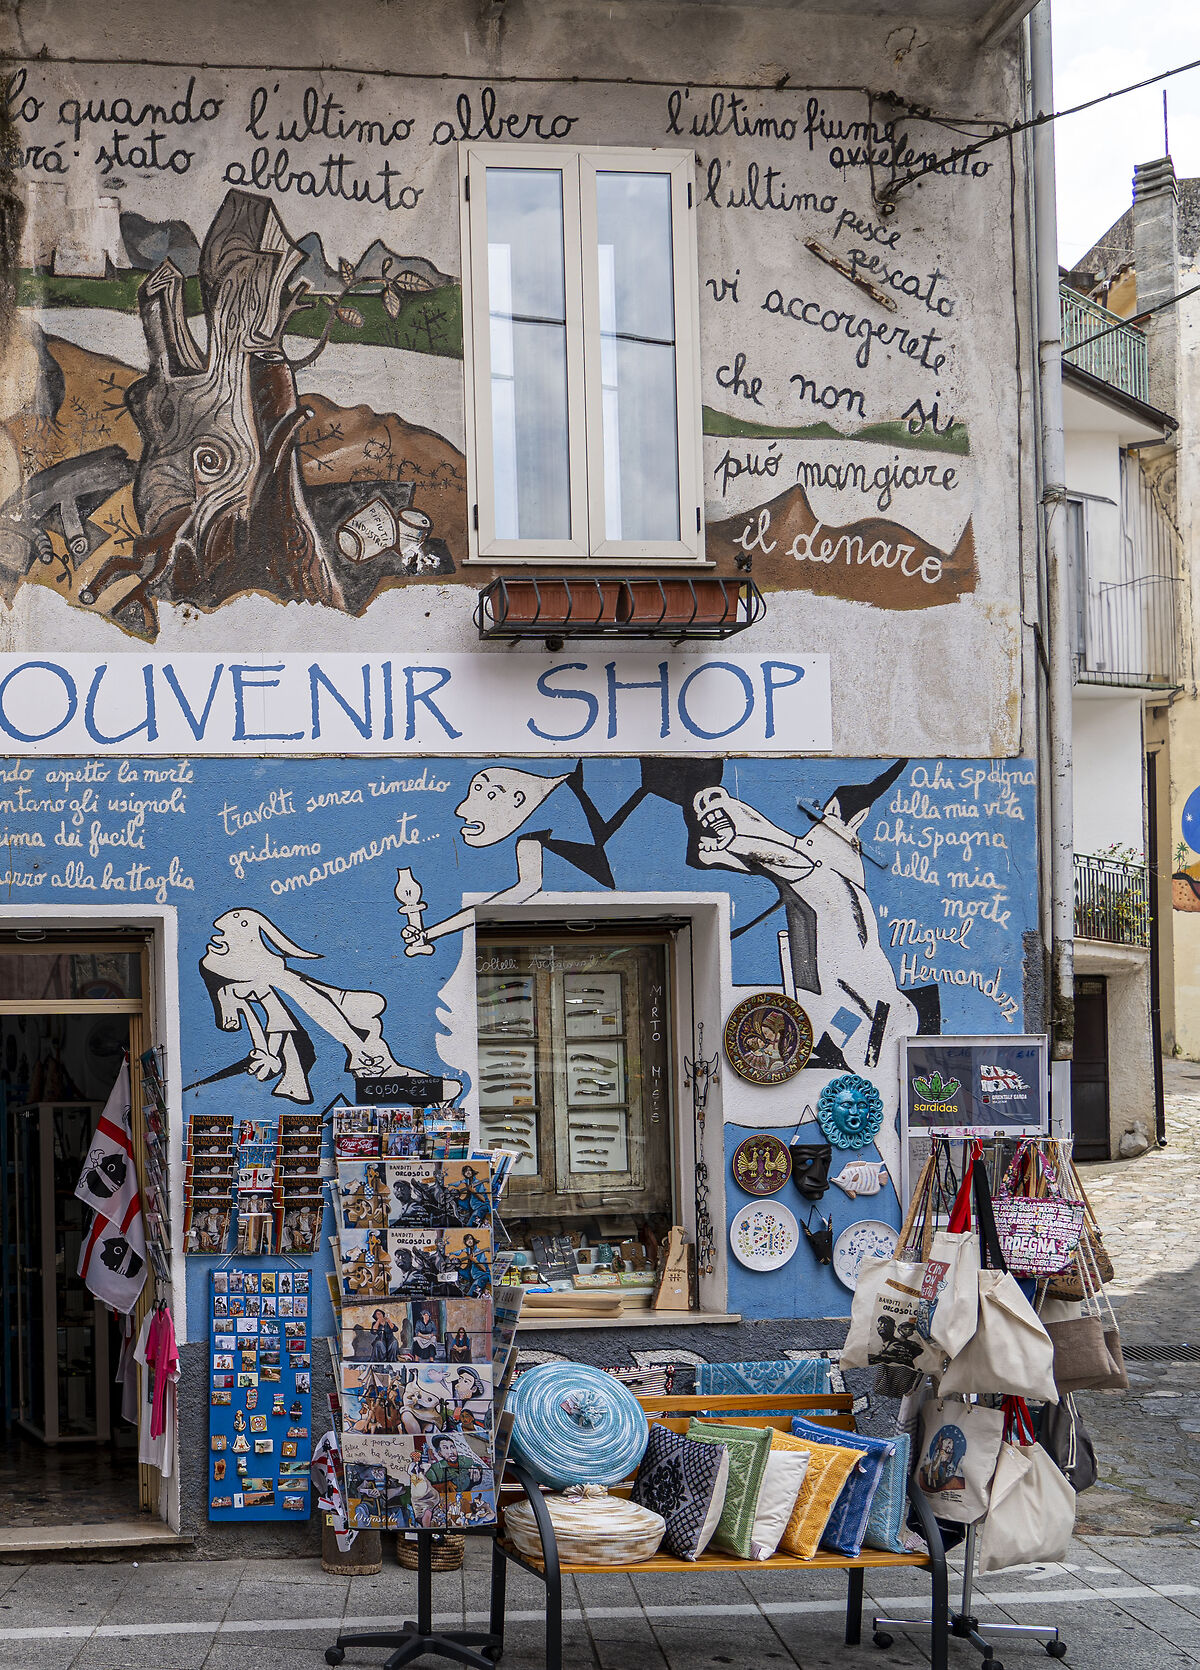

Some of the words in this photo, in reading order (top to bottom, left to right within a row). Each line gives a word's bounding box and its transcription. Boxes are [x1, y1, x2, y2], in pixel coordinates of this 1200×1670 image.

[57, 77, 224, 141] quando
[245, 84, 416, 143] l'ultimo
[430, 87, 579, 146] albero
[665, 88, 797, 139] l'ultimo
[804, 98, 897, 151] fiume
[96, 129, 196, 176] stato
[222, 147, 424, 211] abbattuto
[704, 157, 838, 213] l'ultimo
[832, 207, 901, 250] pesce
[848, 247, 954, 318] pescato
[706, 269, 741, 304] vi
[761, 289, 946, 375] accorgerete
[716, 352, 765, 406] che
[790, 373, 866, 418] non
[902, 391, 954, 434] si
[796, 455, 959, 512] mangiare
[369, 508, 392, 541] RIFIUTI
[733, 508, 777, 555] il
[785, 520, 943, 584] denaro
[527, 659, 807, 742] SHOP
[45, 760, 111, 793] aspetto
[117, 759, 139, 783] la
[143, 759, 195, 784] morte
[958, 767, 1037, 799] Spagna
[69, 788, 100, 826] gli
[108, 787, 188, 828] usignoli
[218, 788, 296, 836] travolti
[306, 787, 364, 813] senza
[368, 767, 451, 797] rimedio
[890, 789, 941, 819] della
[943, 799, 980, 818] mia
[983, 792, 1025, 821] vita
[54, 820, 83, 848] dei
[89, 820, 146, 858] fucili
[229, 833, 321, 879] gridiamo
[918, 826, 1008, 862] Spagna
[51, 860, 97, 890] alla
[100, 856, 195, 902] battaglia
[891, 850, 940, 886] della
[947, 867, 1007, 890] mia
[941, 892, 1011, 930] morte
[476, 956, 518, 972] Coltelli
[900, 953, 1020, 1024] Hernandez
[650, 985, 662, 1041] MIRTO
[913, 1102, 959, 1113] sardidas
